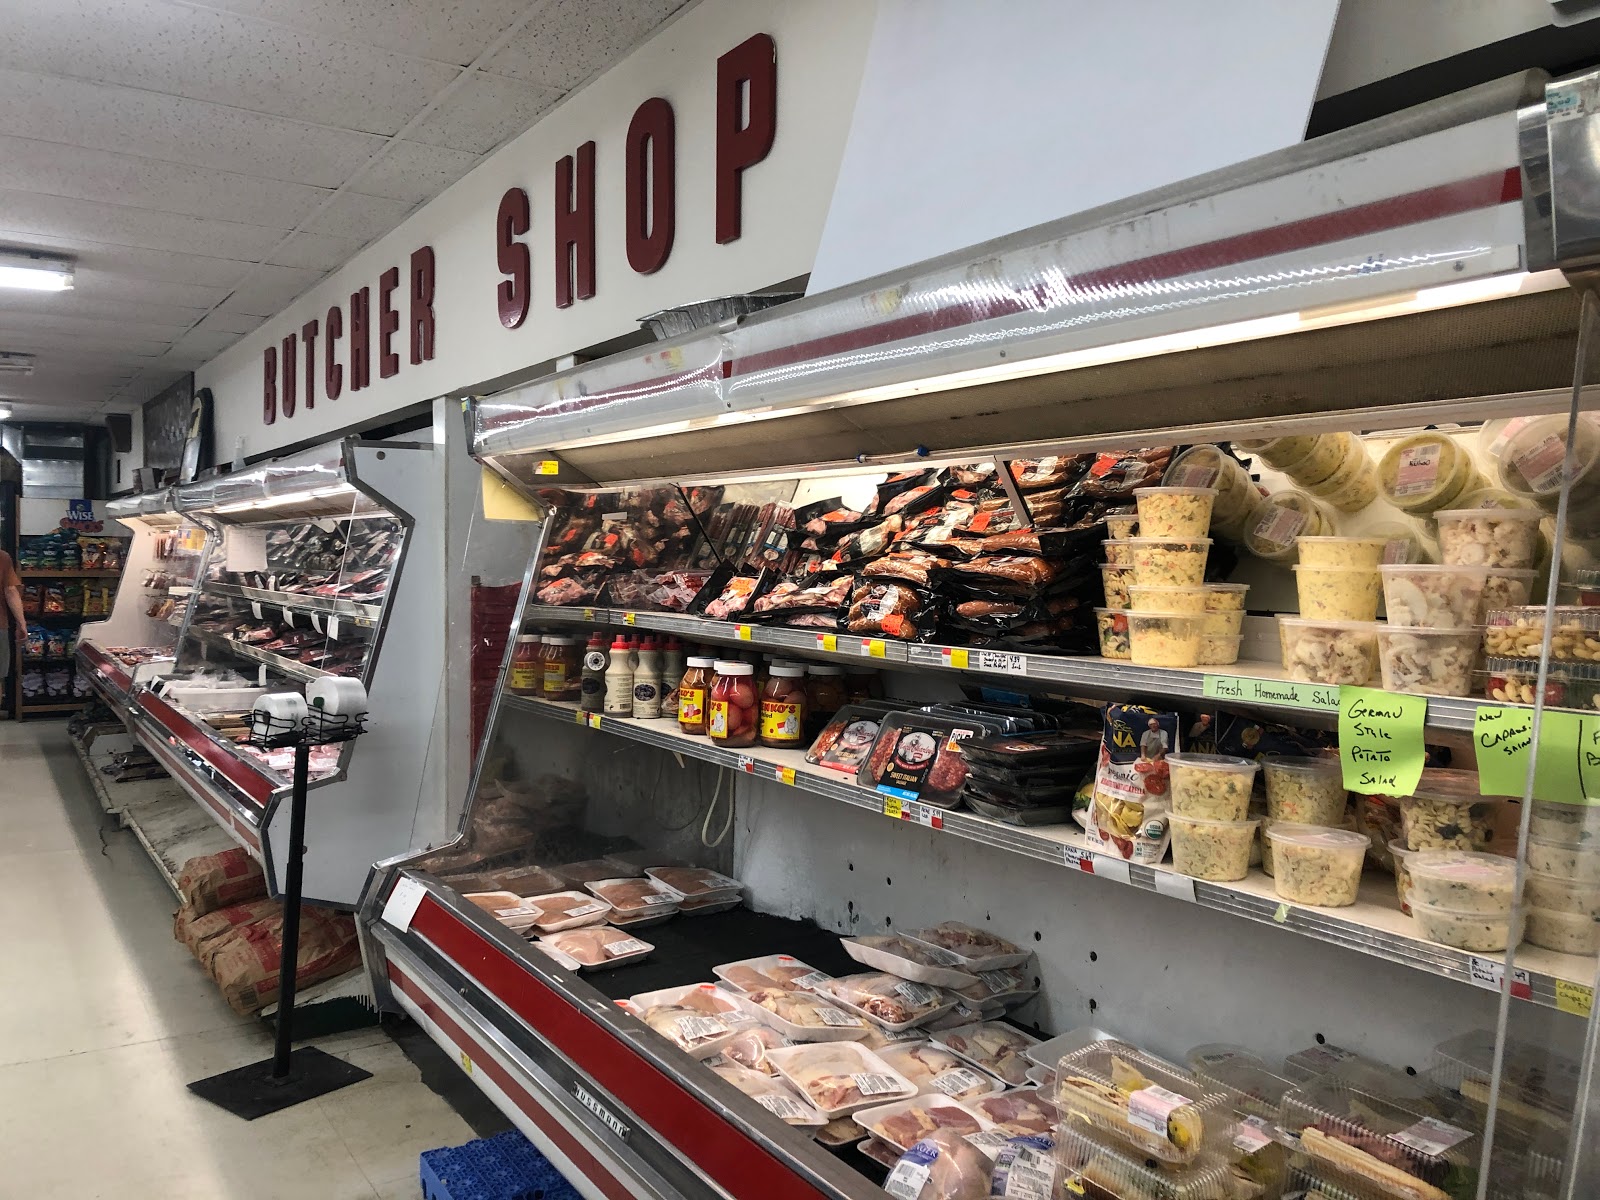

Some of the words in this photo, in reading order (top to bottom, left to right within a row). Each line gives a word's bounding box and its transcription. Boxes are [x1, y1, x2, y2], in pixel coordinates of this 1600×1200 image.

[263, 245, 435, 425] BUTCHER
[497, 33, 777, 329] SHOP
[66, 510, 94, 521] WISE
[1216, 680, 1242, 696] Fresh
[1254, 683, 1300, 702] Homemade
[1312, 690, 1340, 706] Sala
